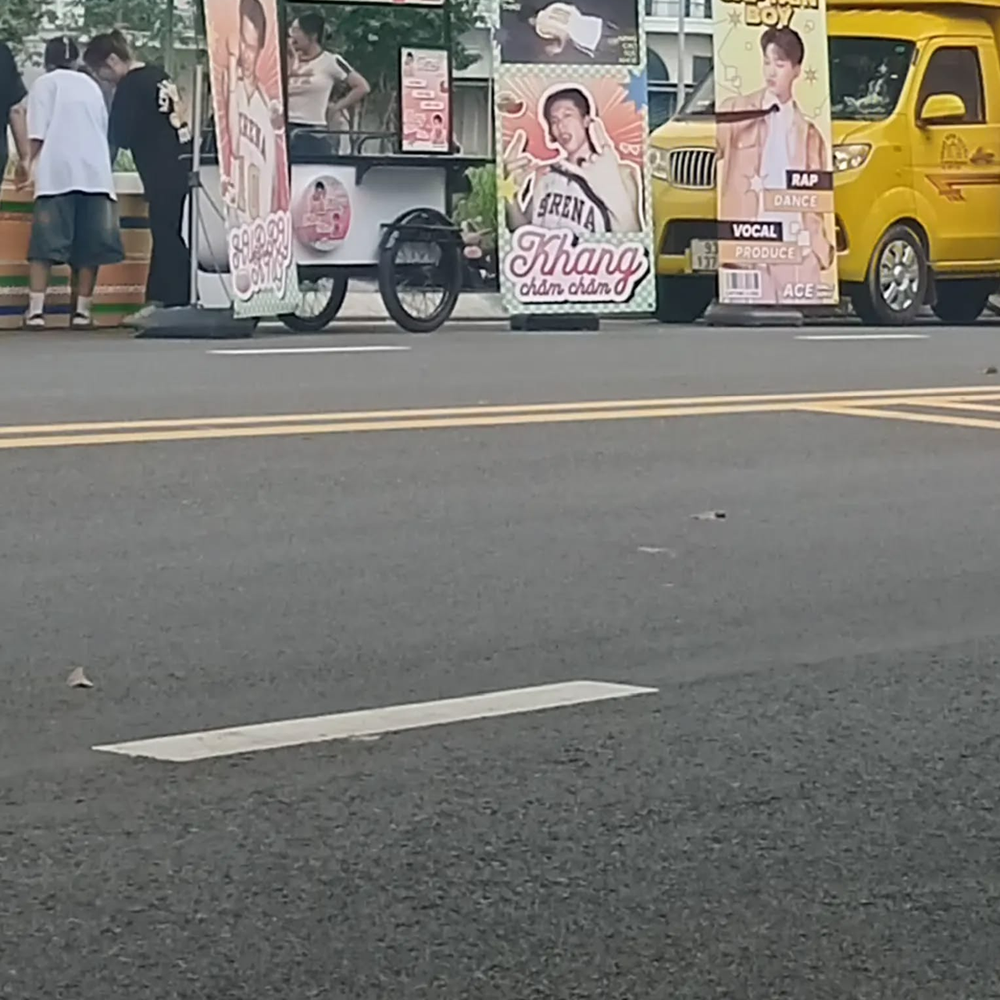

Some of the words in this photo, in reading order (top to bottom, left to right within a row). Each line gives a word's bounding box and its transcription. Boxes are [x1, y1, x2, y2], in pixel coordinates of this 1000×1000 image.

[745, 4, 795, 28] BOY
[791, 173, 819, 187] RAP
[774, 195, 818, 208] DANCE
[732, 223, 778, 238] VOCAL
[735, 246, 795, 260] PRODUCE
[510, 231, 643, 296] Khang
[783, 283, 815, 298] ACE
